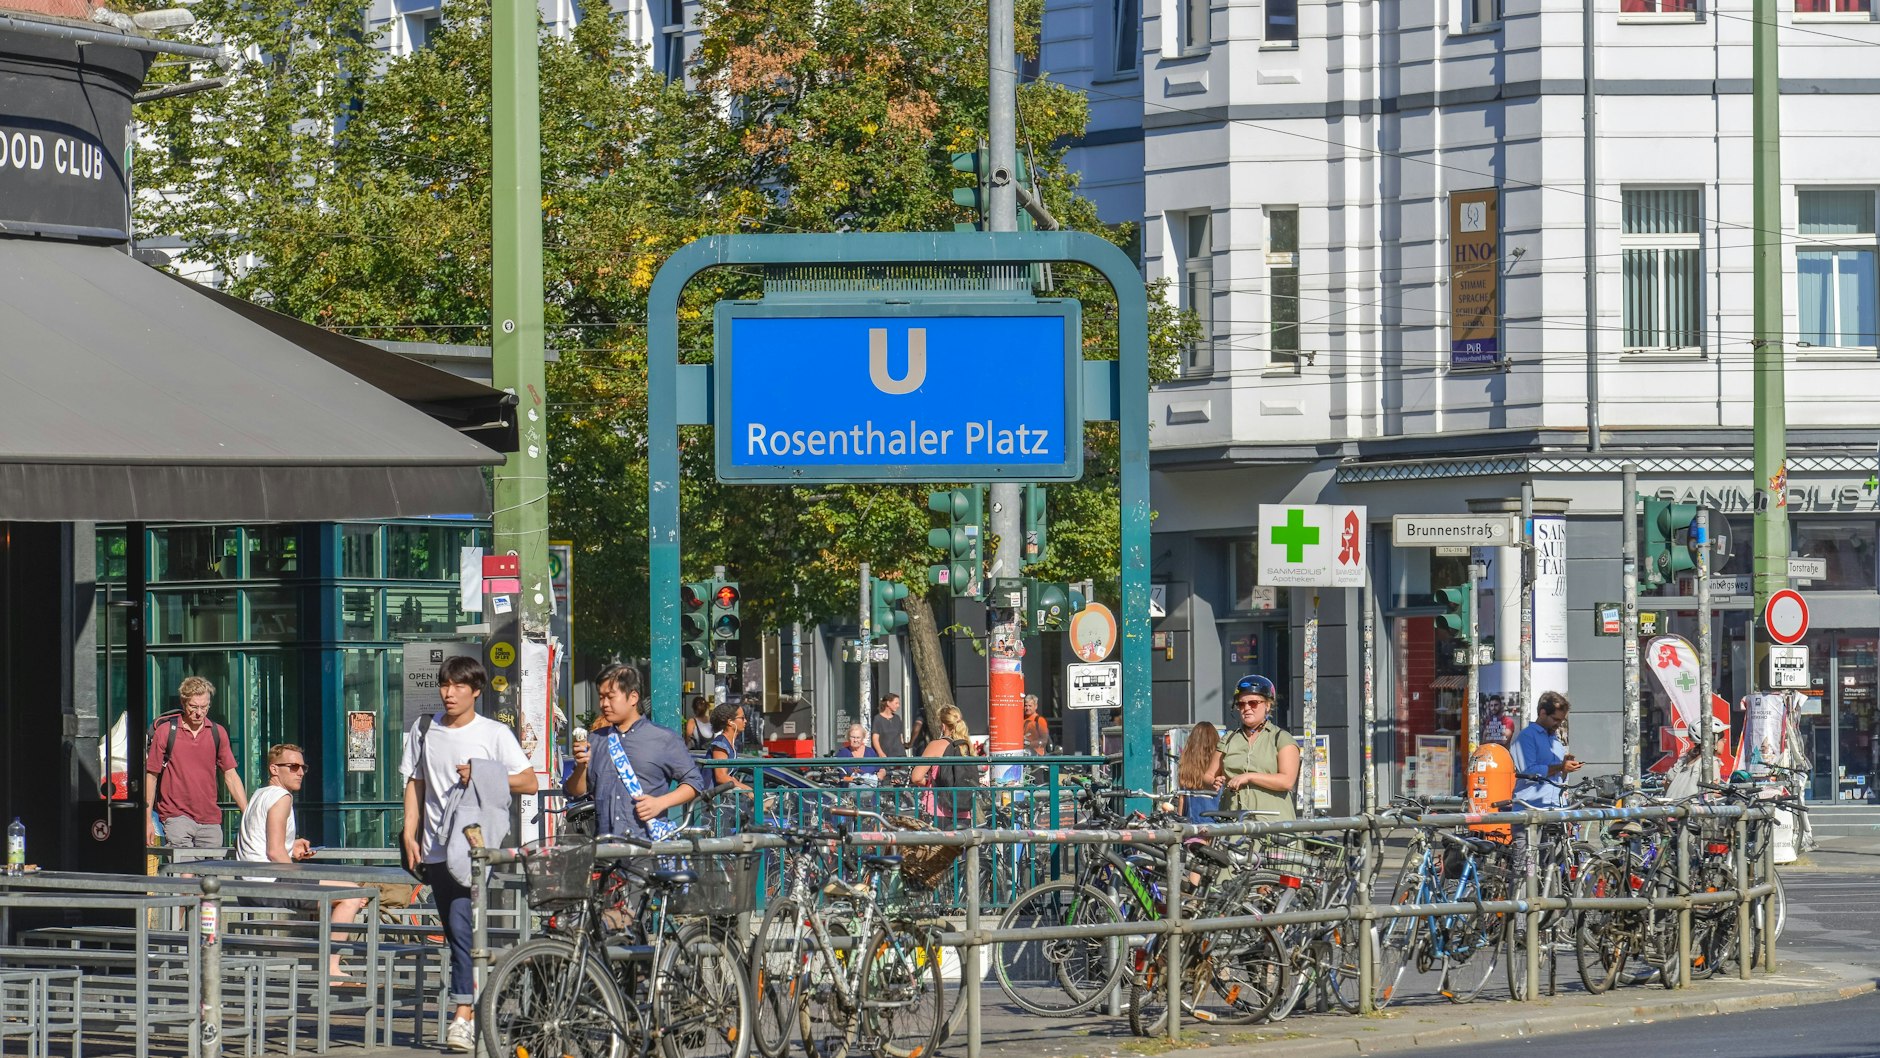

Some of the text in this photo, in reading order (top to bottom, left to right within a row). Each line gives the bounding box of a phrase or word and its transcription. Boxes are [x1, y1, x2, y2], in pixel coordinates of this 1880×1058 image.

[55, 138, 103, 180] CLUB
[1455, 242, 1493, 262] HNO
[1460, 280, 1487, 290] STIMME
[1458, 293, 1489, 303] SPRACHE
[868, 328, 927, 395] U
[748, 420, 1049, 456] Rosenthaler Platz
[1656, 485, 1862, 506] SANIMDIUS
[1407, 523, 1493, 539] Brunnenstraß
[1789, 562, 1818, 573] Torstraße
[1783, 672, 1796, 681] frei
[1087, 692, 1103, 702] frei
